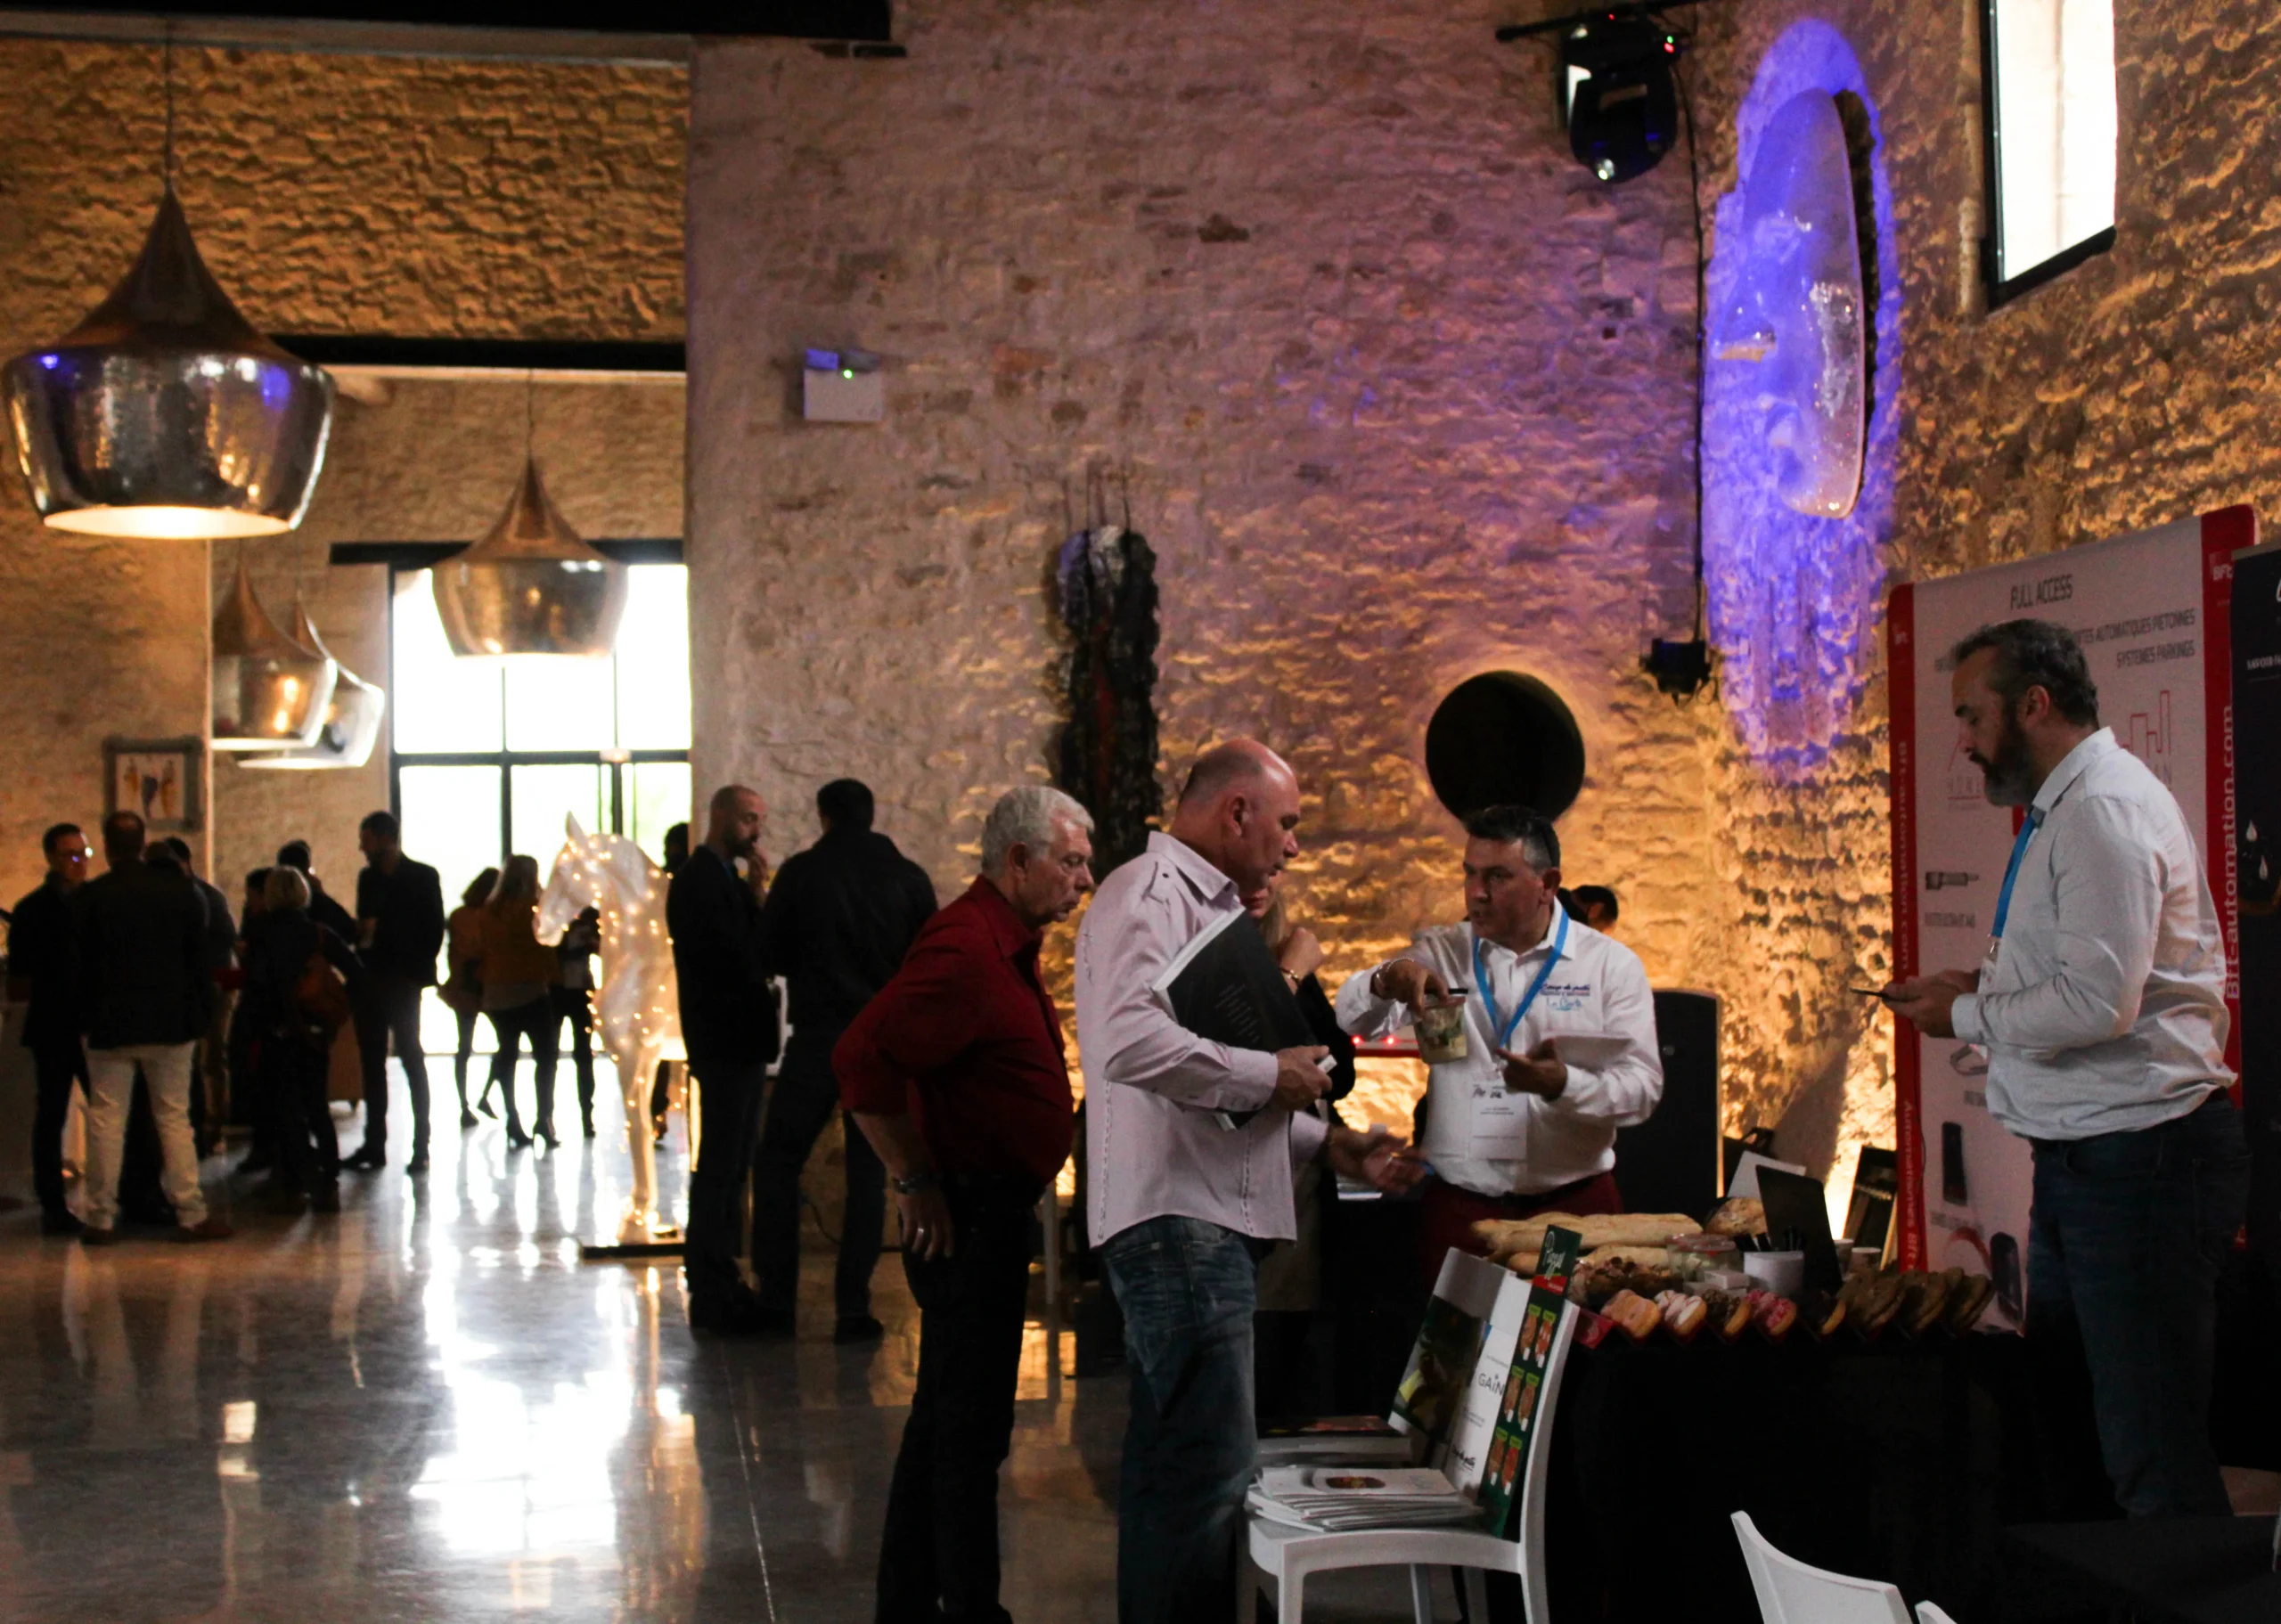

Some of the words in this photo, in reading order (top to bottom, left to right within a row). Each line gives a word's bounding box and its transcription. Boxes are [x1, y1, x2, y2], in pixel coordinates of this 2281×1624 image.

[2010, 584, 2033, 610] FULL
[2037, 574, 2073, 605] ACCESS
[2222, 705, 2239, 1000] Bft-automation.com
